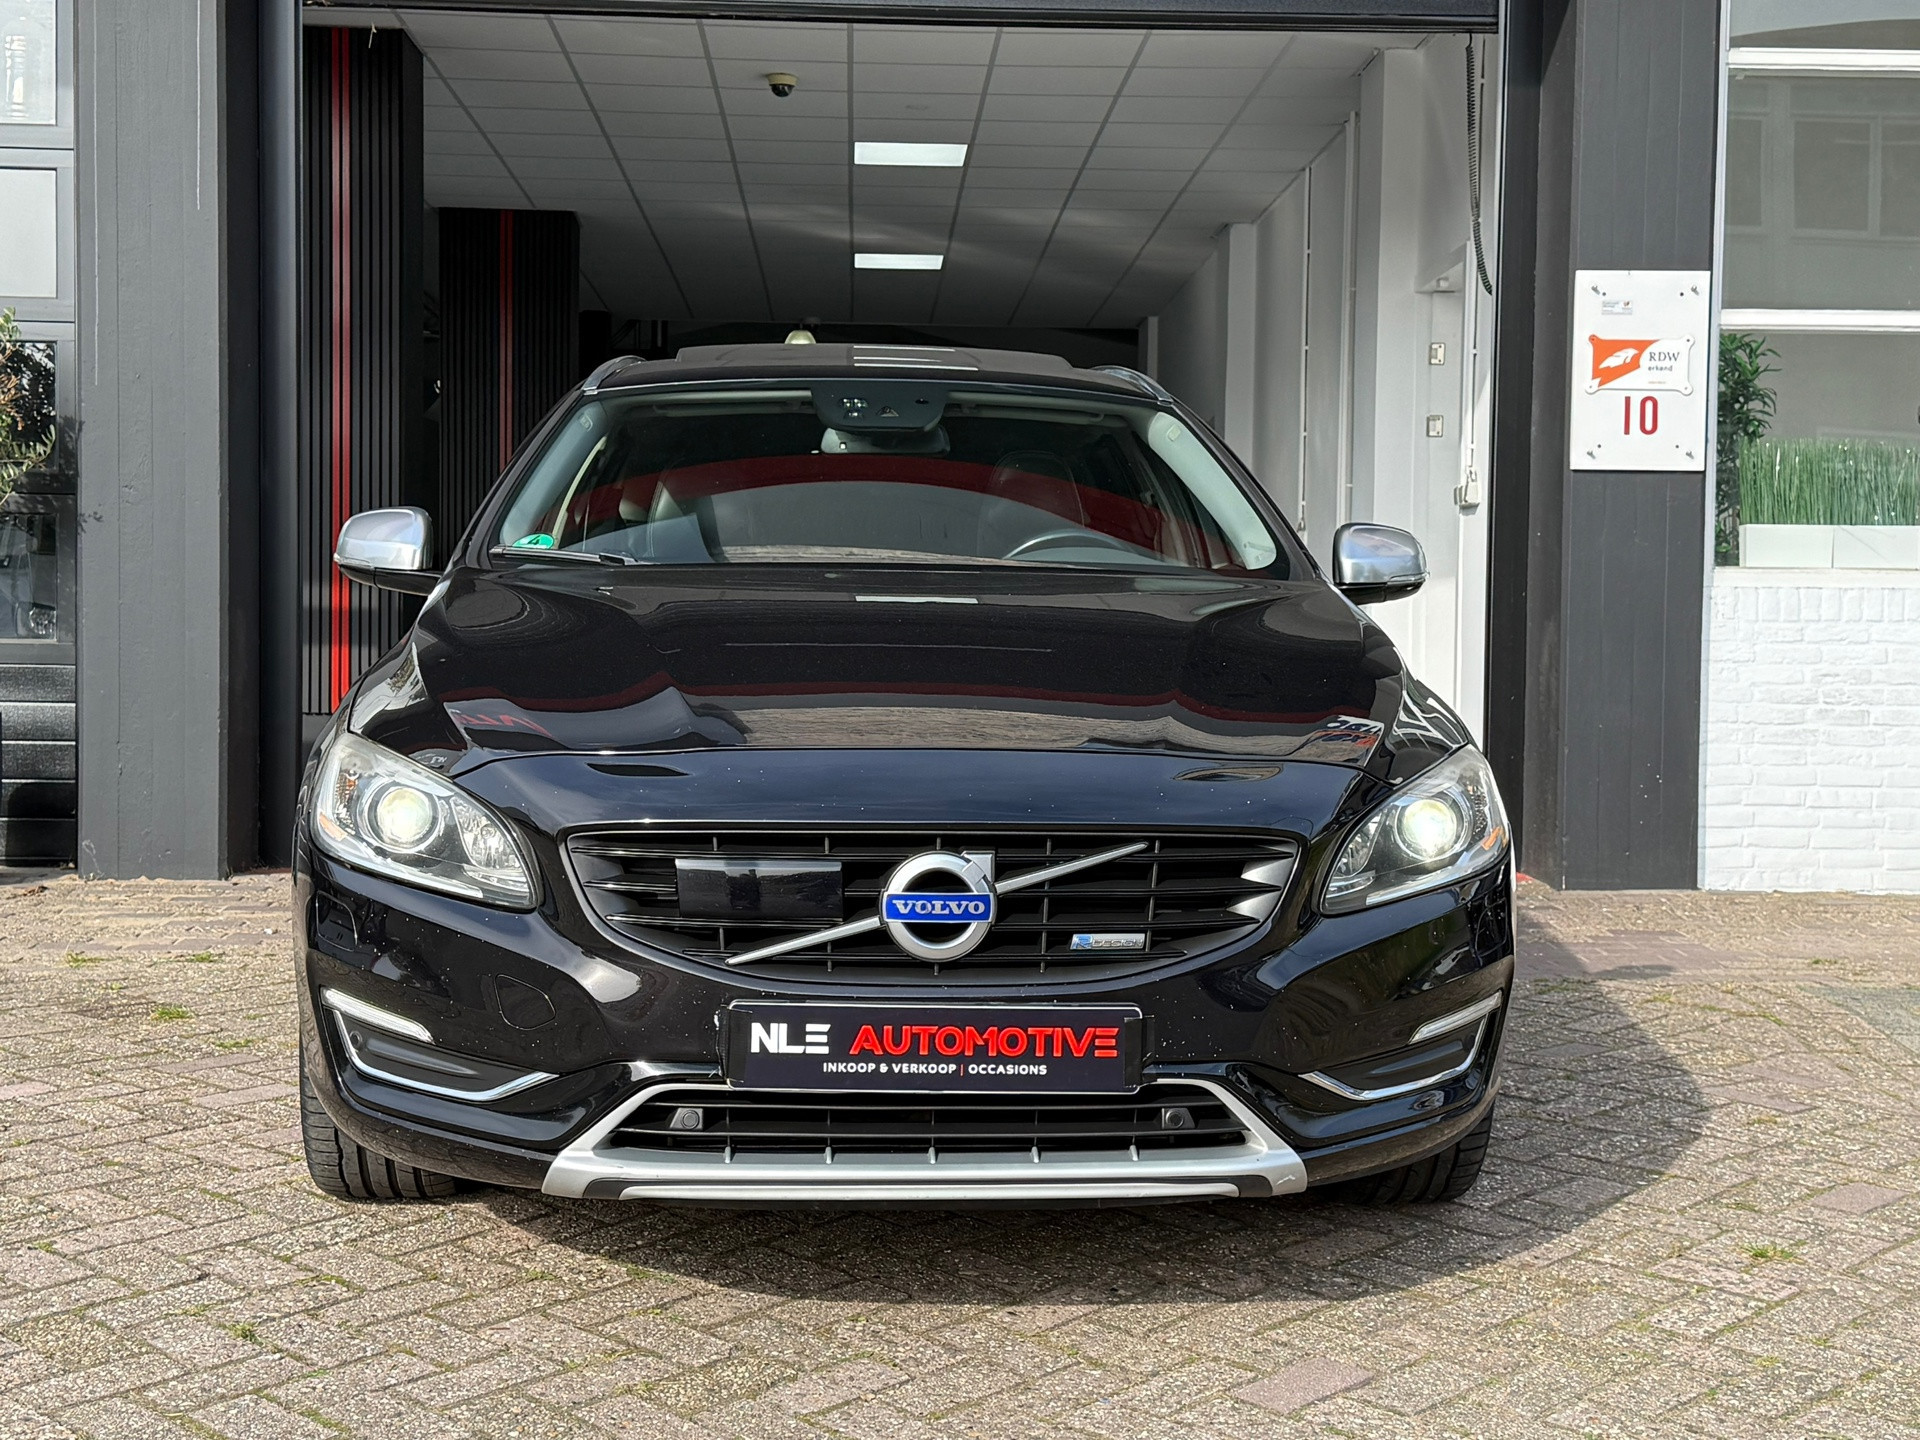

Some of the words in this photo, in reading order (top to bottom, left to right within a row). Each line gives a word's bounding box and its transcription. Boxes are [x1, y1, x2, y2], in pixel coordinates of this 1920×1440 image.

[1649, 351, 1680, 362] RDW
[1624, 396, 1658, 435] 10
[891, 899, 986, 915] VOLVO
[750, 1022, 831, 1055] NLE
[849, 1024, 1119, 1057] AUTOMOTIVE
[823, 1063, 876, 1073] INKOOP
[879, 1063, 888, 1073] &
[892, 1063, 957, 1075] VERKOOP
[968, 1064, 1048, 1075] OCCASIONS
